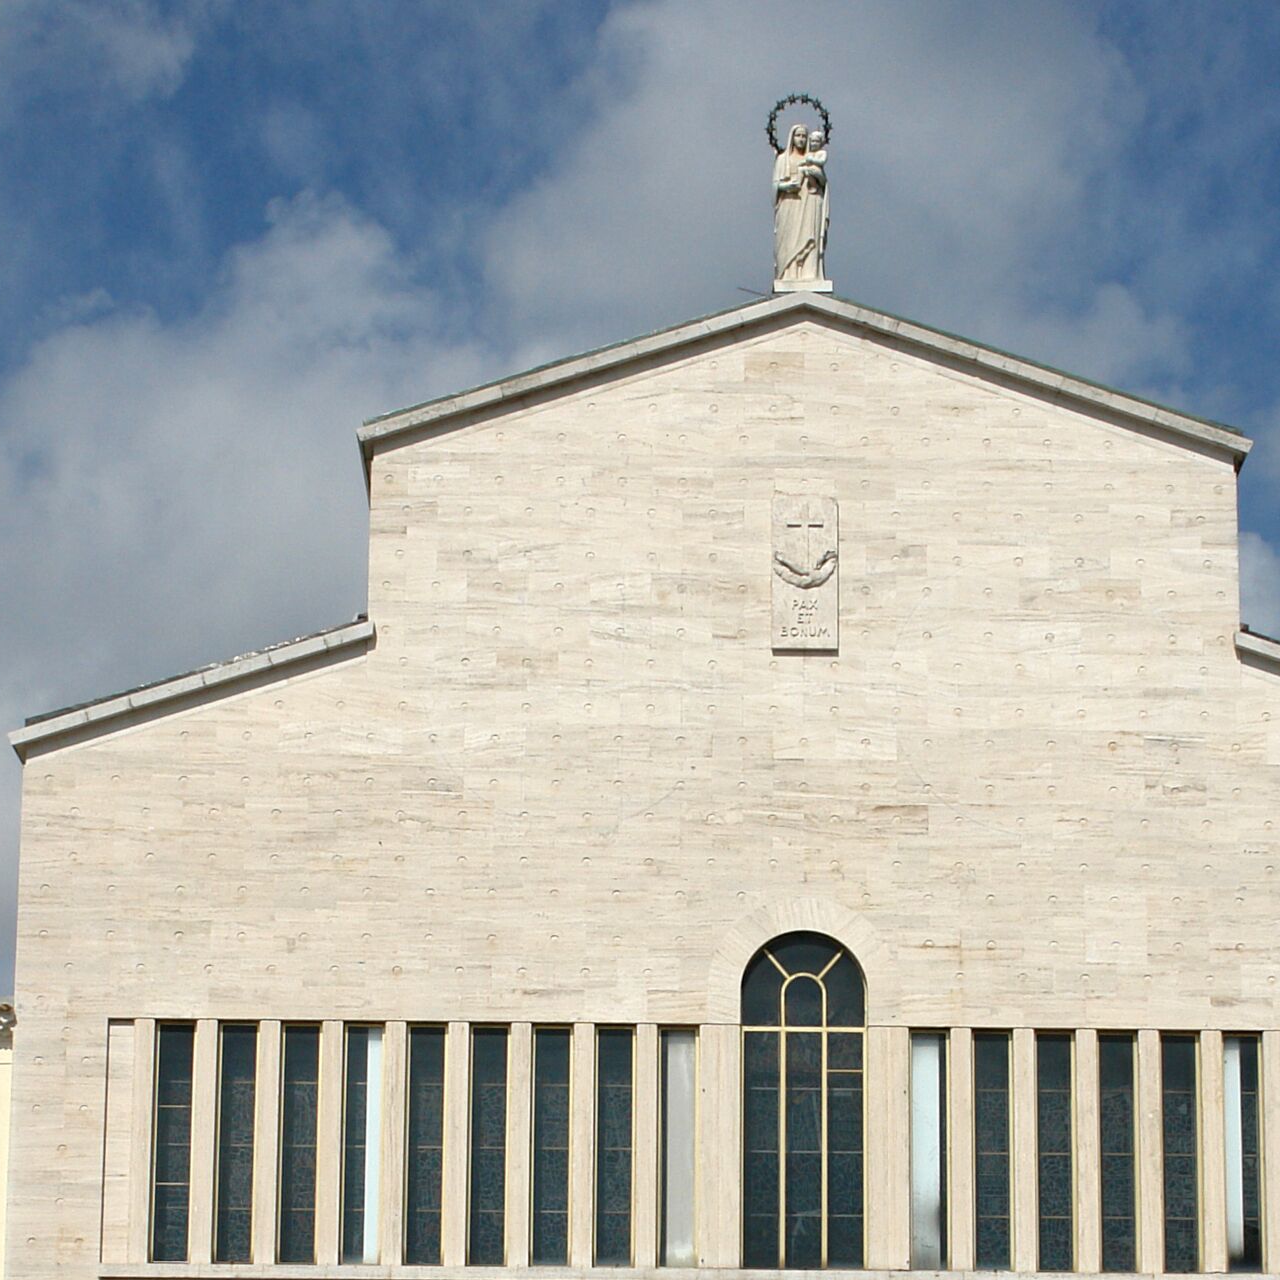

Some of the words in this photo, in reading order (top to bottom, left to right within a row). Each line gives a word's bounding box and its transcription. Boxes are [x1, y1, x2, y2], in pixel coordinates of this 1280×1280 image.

[792, 599, 818, 611] PAX
[797, 613, 813, 624] ET
[780, 626, 830, 638] BONUM
